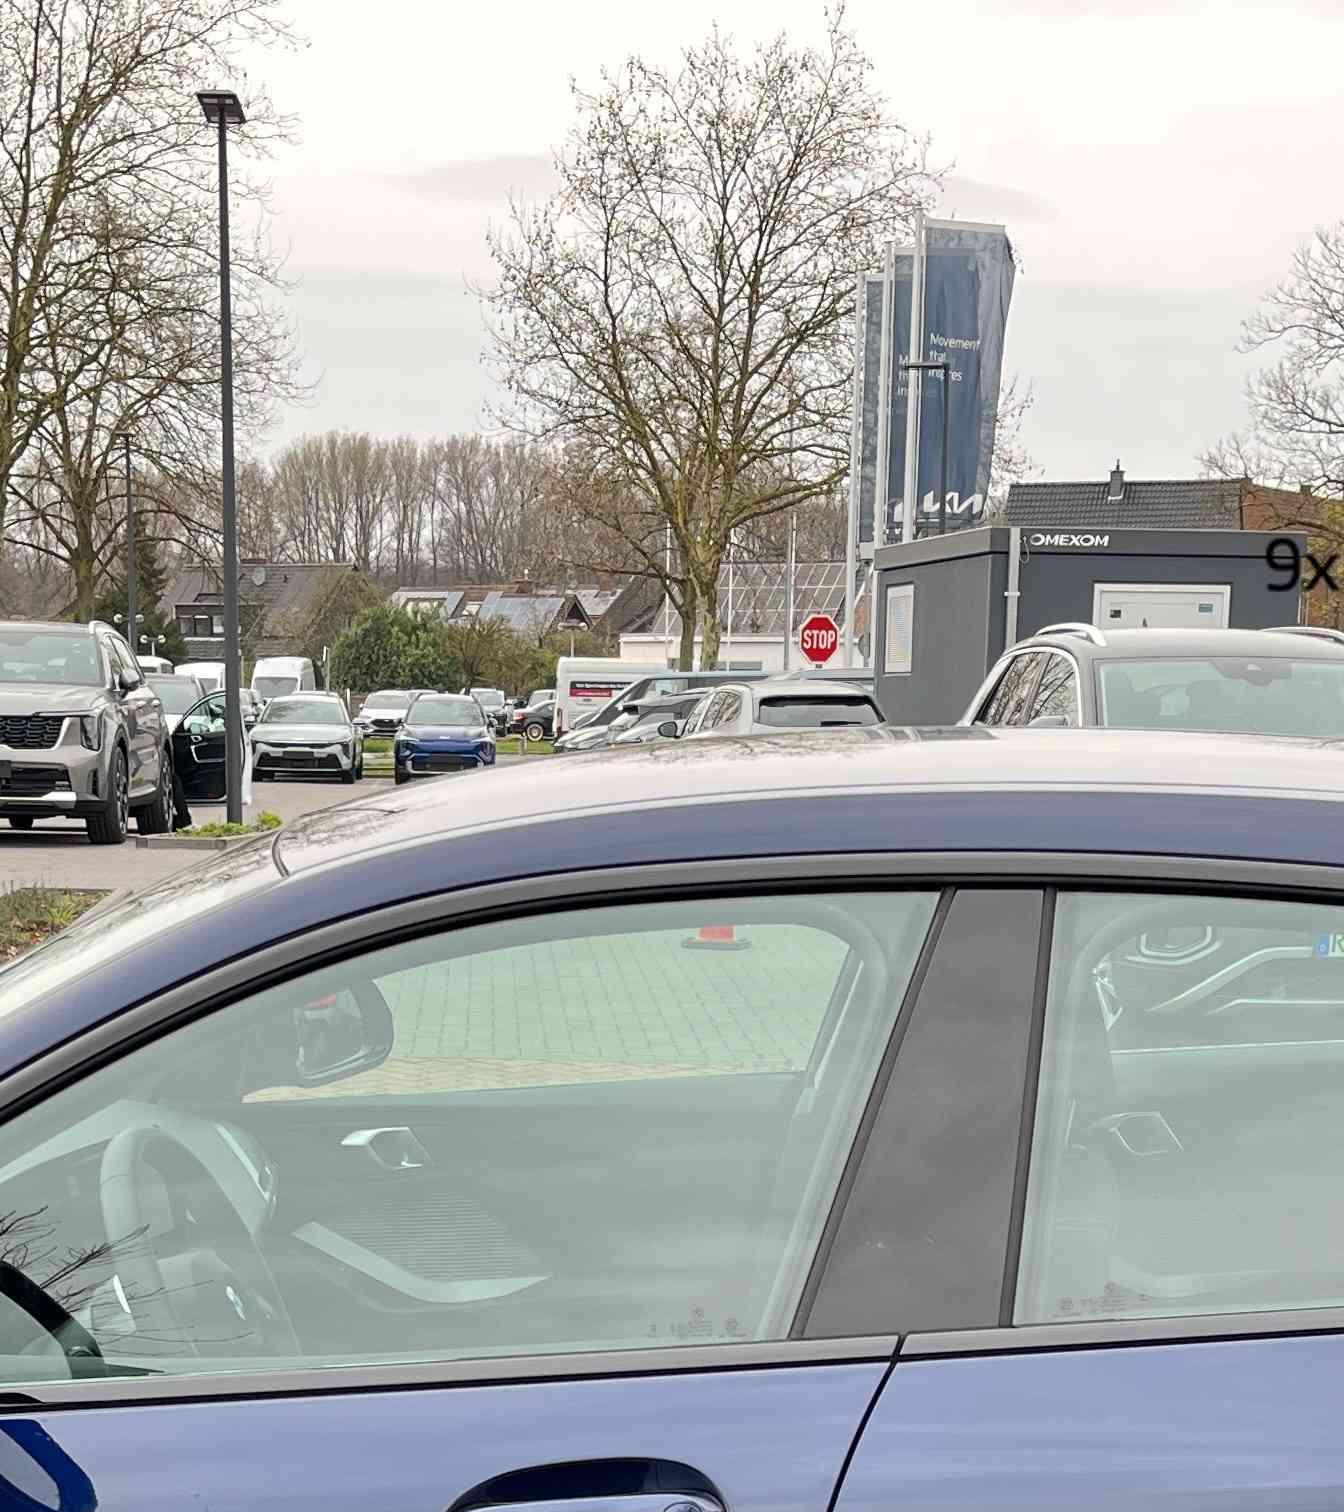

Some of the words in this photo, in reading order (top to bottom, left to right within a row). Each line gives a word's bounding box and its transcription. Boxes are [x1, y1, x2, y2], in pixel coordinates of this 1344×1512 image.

[929, 332, 981, 351] Movement
[1029, 532, 1110, 547] OMEXOM
[802, 629, 836, 650] STOP
